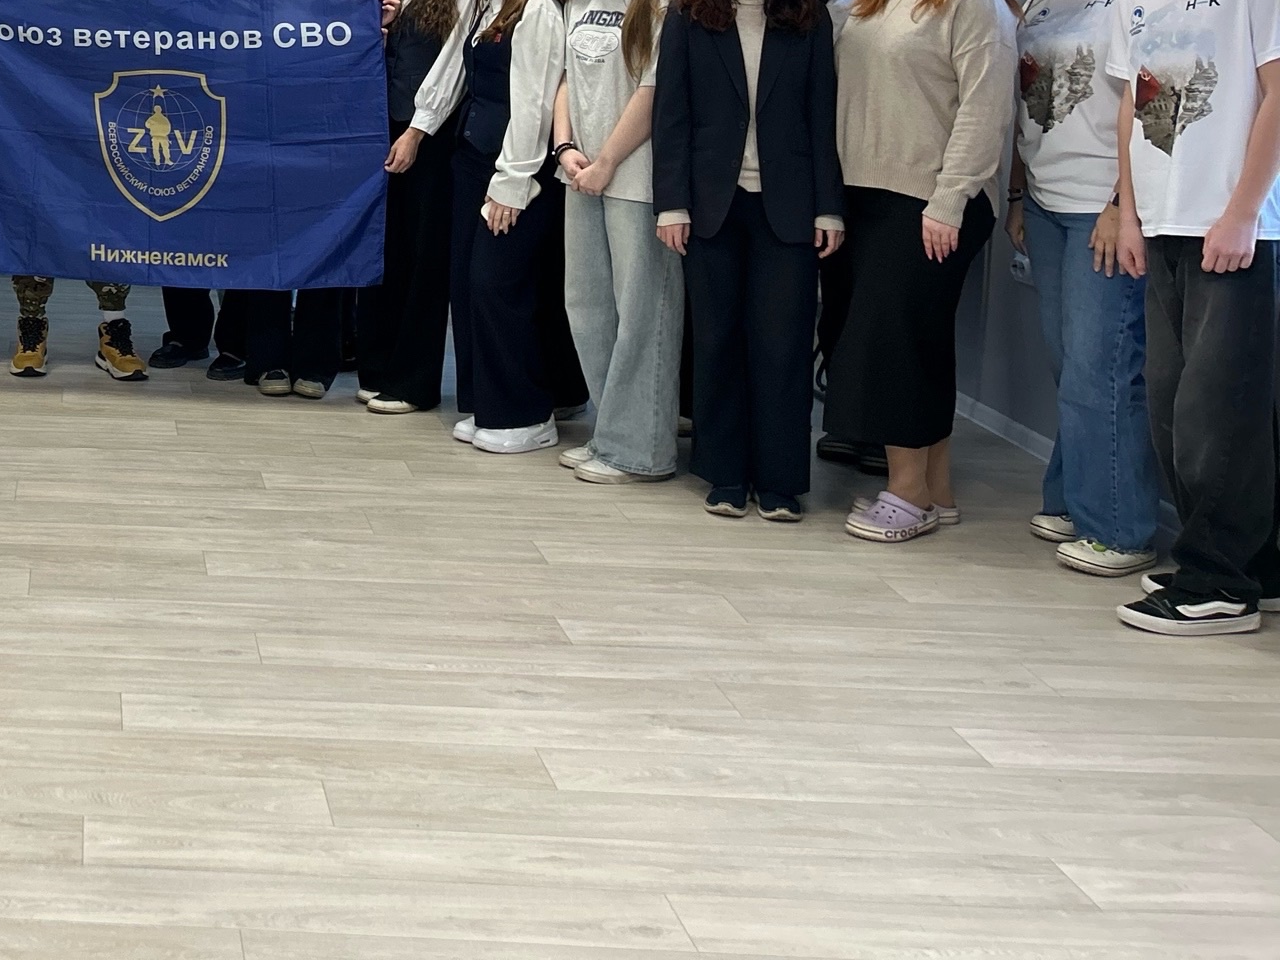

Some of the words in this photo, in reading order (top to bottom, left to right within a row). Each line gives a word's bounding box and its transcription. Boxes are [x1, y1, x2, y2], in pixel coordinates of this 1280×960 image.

[73, 28, 263, 56] ветеранов
[273, 21, 352, 48] СВО
[127, 128, 147, 153] Z
[174, 130, 198, 155] V
[108, 121, 148, 192] ВСЕРОССИЙСКИЙ
[148, 187, 176, 197] СОЮЗ
[176, 146, 211, 193] ВЕТЕРАНОВ
[205, 125, 214, 145] СВО
[90, 243, 229, 268] Нижнекамск
[884, 526, 919, 539] crocs
